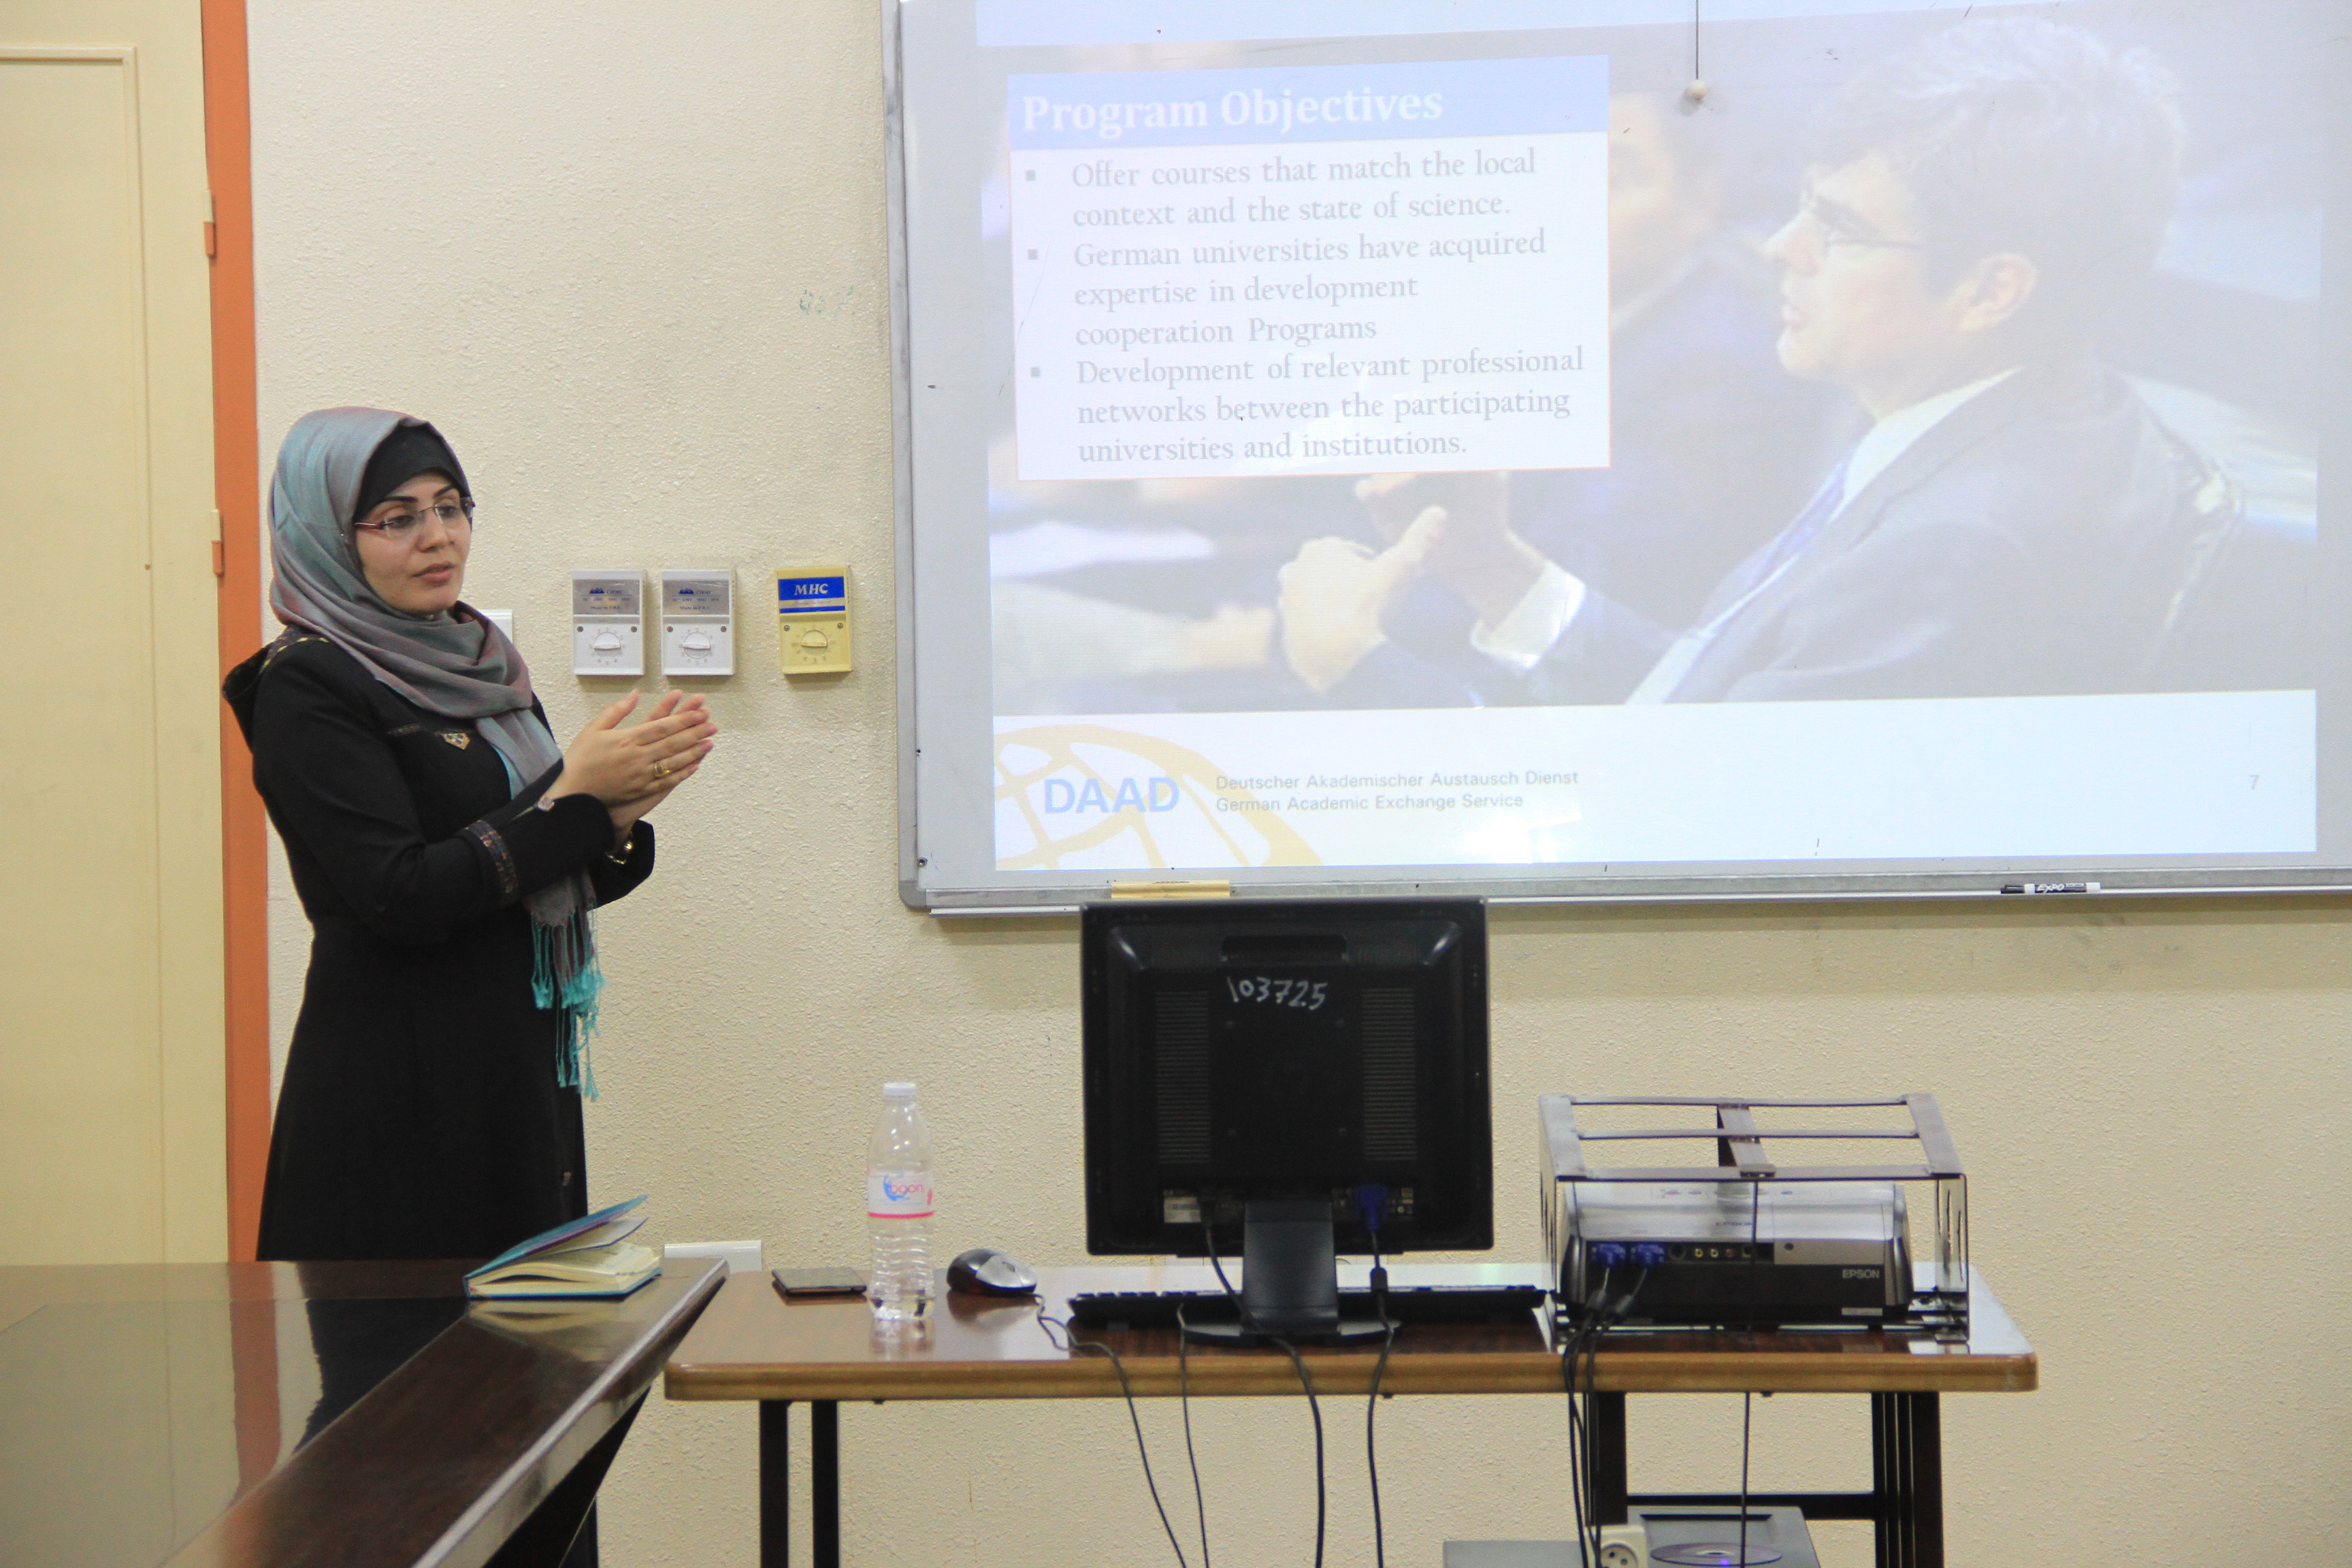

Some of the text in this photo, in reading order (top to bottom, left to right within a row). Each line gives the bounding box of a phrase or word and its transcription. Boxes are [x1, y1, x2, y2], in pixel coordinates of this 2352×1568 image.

[1023, 88, 1442, 139] Program Objectives
[1073, 147, 1535, 186] Offer courses that match the local
[1073, 192, 1509, 227] context and the state of science.
[1074, 227, 1546, 267] German universities have acquired
[1075, 275, 1418, 312] expertise in development
[1076, 318, 1376, 352] cooperation Programs
[1077, 345, 1583, 390] Development of relevant professional
[1078, 390, 1570, 423] networks between the participating
[1079, 431, 1467, 462] universities and institutions.
[794, 583, 828, 595] MHC
[1044, 777, 1179, 813] DAAD
[1216, 770, 1578, 789] Deutscher Akademischer Austausch Dienst
[2249, 774, 2259, 790] 7
[1216, 793, 1523, 812] German Academic Exchange Service
[2036, 884, 2065, 893] EXPO
[1226, 976, 1328, 1011] 103725
[1842, 1269, 1880, 1279] EPSON
